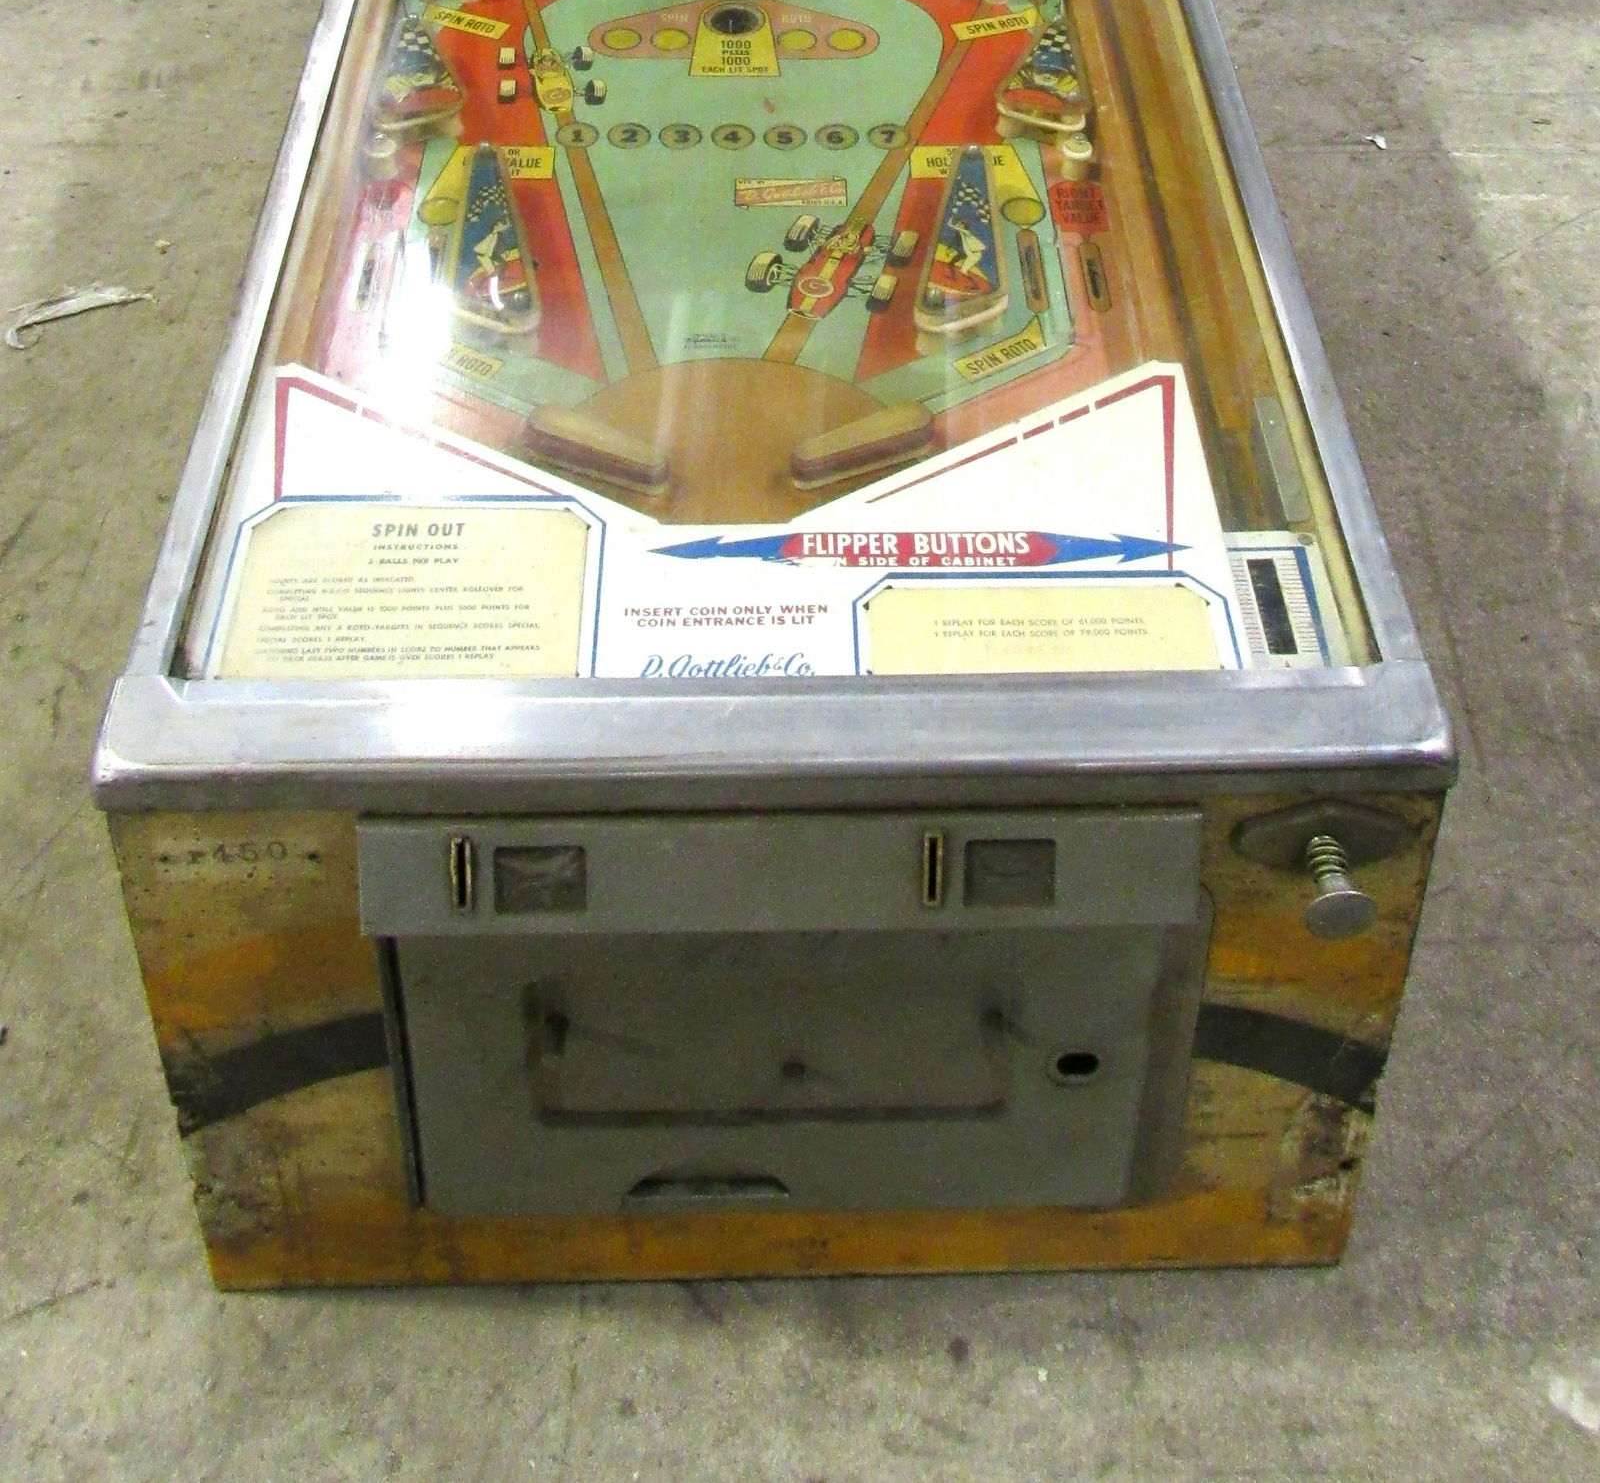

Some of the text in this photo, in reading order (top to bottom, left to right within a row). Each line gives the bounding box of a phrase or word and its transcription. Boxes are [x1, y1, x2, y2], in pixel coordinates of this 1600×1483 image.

[433, 9, 496, 34] SPIN ROTO
[965, 15, 1029, 35] SPIN ROTO
[720, 39, 752, 50] 1000
[721, 56, 751, 66] 1000
[746, 65, 770, 73] SPOT
[620, 129, 639, 143] 2
[673, 129, 692, 143] 3
[722, 129, 742, 143] 4
[776, 130, 794, 145] 5
[826, 130, 845, 145] 6
[879, 129, 898, 144] 7
[926, 157, 951, 168] HOL
[966, 338, 1036, 375] SPIN ROTO
[371, 522, 466, 538] SPIN OUT
[373, 543, 459, 551] INSTRUCTIONS
[802, 532, 1031, 555] FLIPPER BUTTONS
[433, 557, 459, 565] PLAY
[858, 556, 900, 567] SIDE
[909, 556, 929, 567] OF
[940, 556, 1017, 567] CABINET
[623, 604, 829, 617] INSERT COIN ONLY WHEN
[637, 615, 815, 628] COIN ENTRANCE IS LIT
[1028, 618, 1057, 626] SCORE
[1061, 618, 1075, 626] OF
[1030, 629, 1059, 637] SCORE
